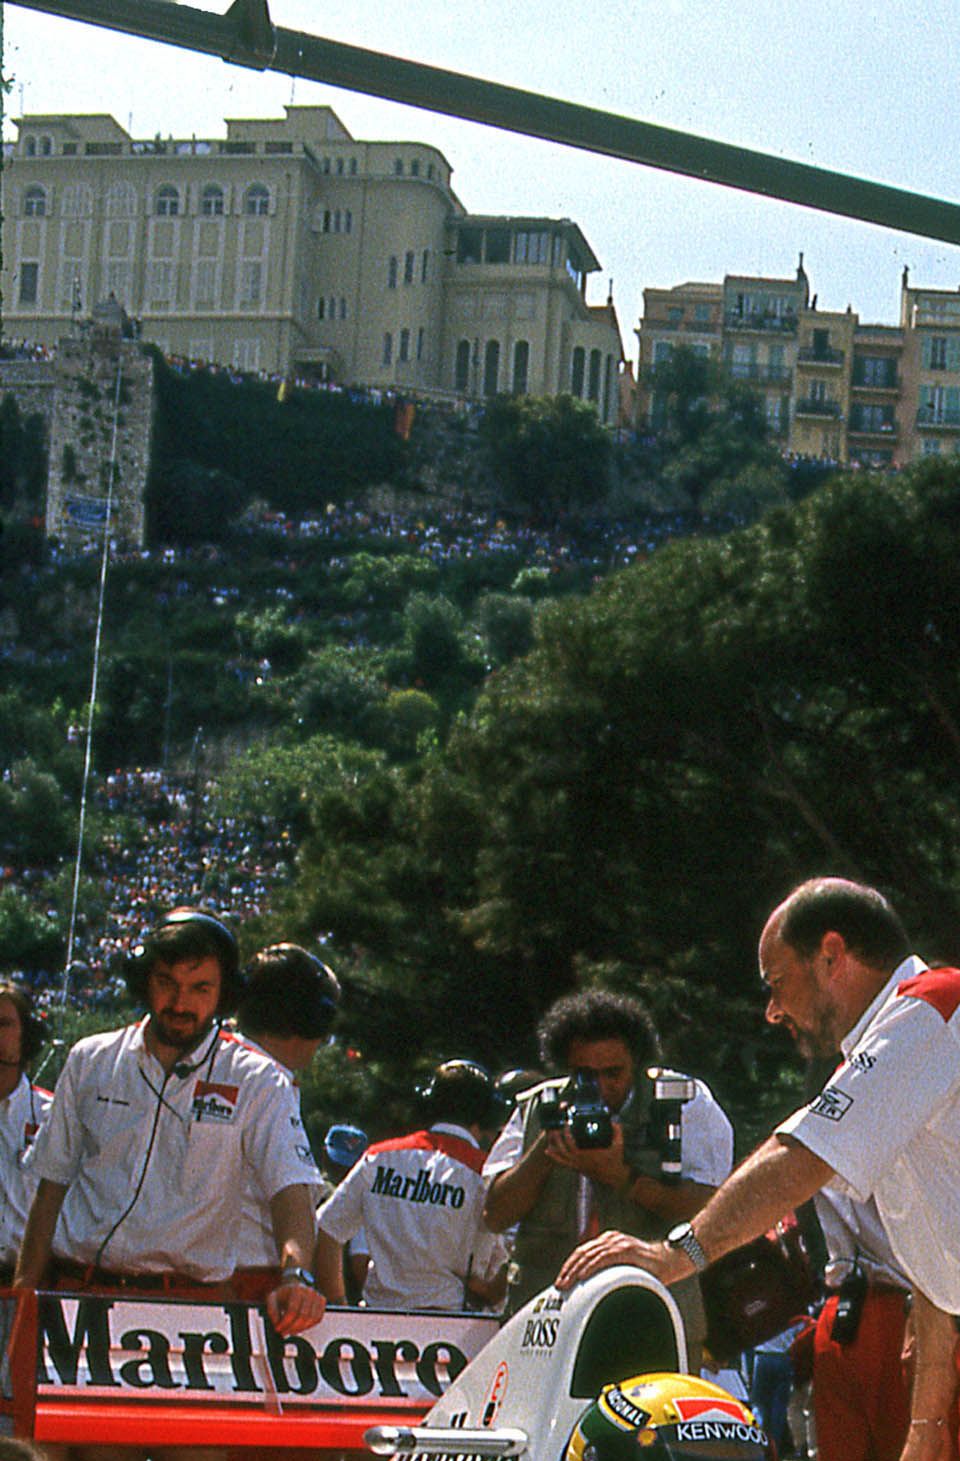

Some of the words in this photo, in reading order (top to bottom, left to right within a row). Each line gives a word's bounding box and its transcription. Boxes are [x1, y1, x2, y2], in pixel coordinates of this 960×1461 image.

[371, 1165, 466, 1209] Marlboro
[37, 1298, 469, 1397] Marlboro
[522, 1318, 560, 1348] BOSS
